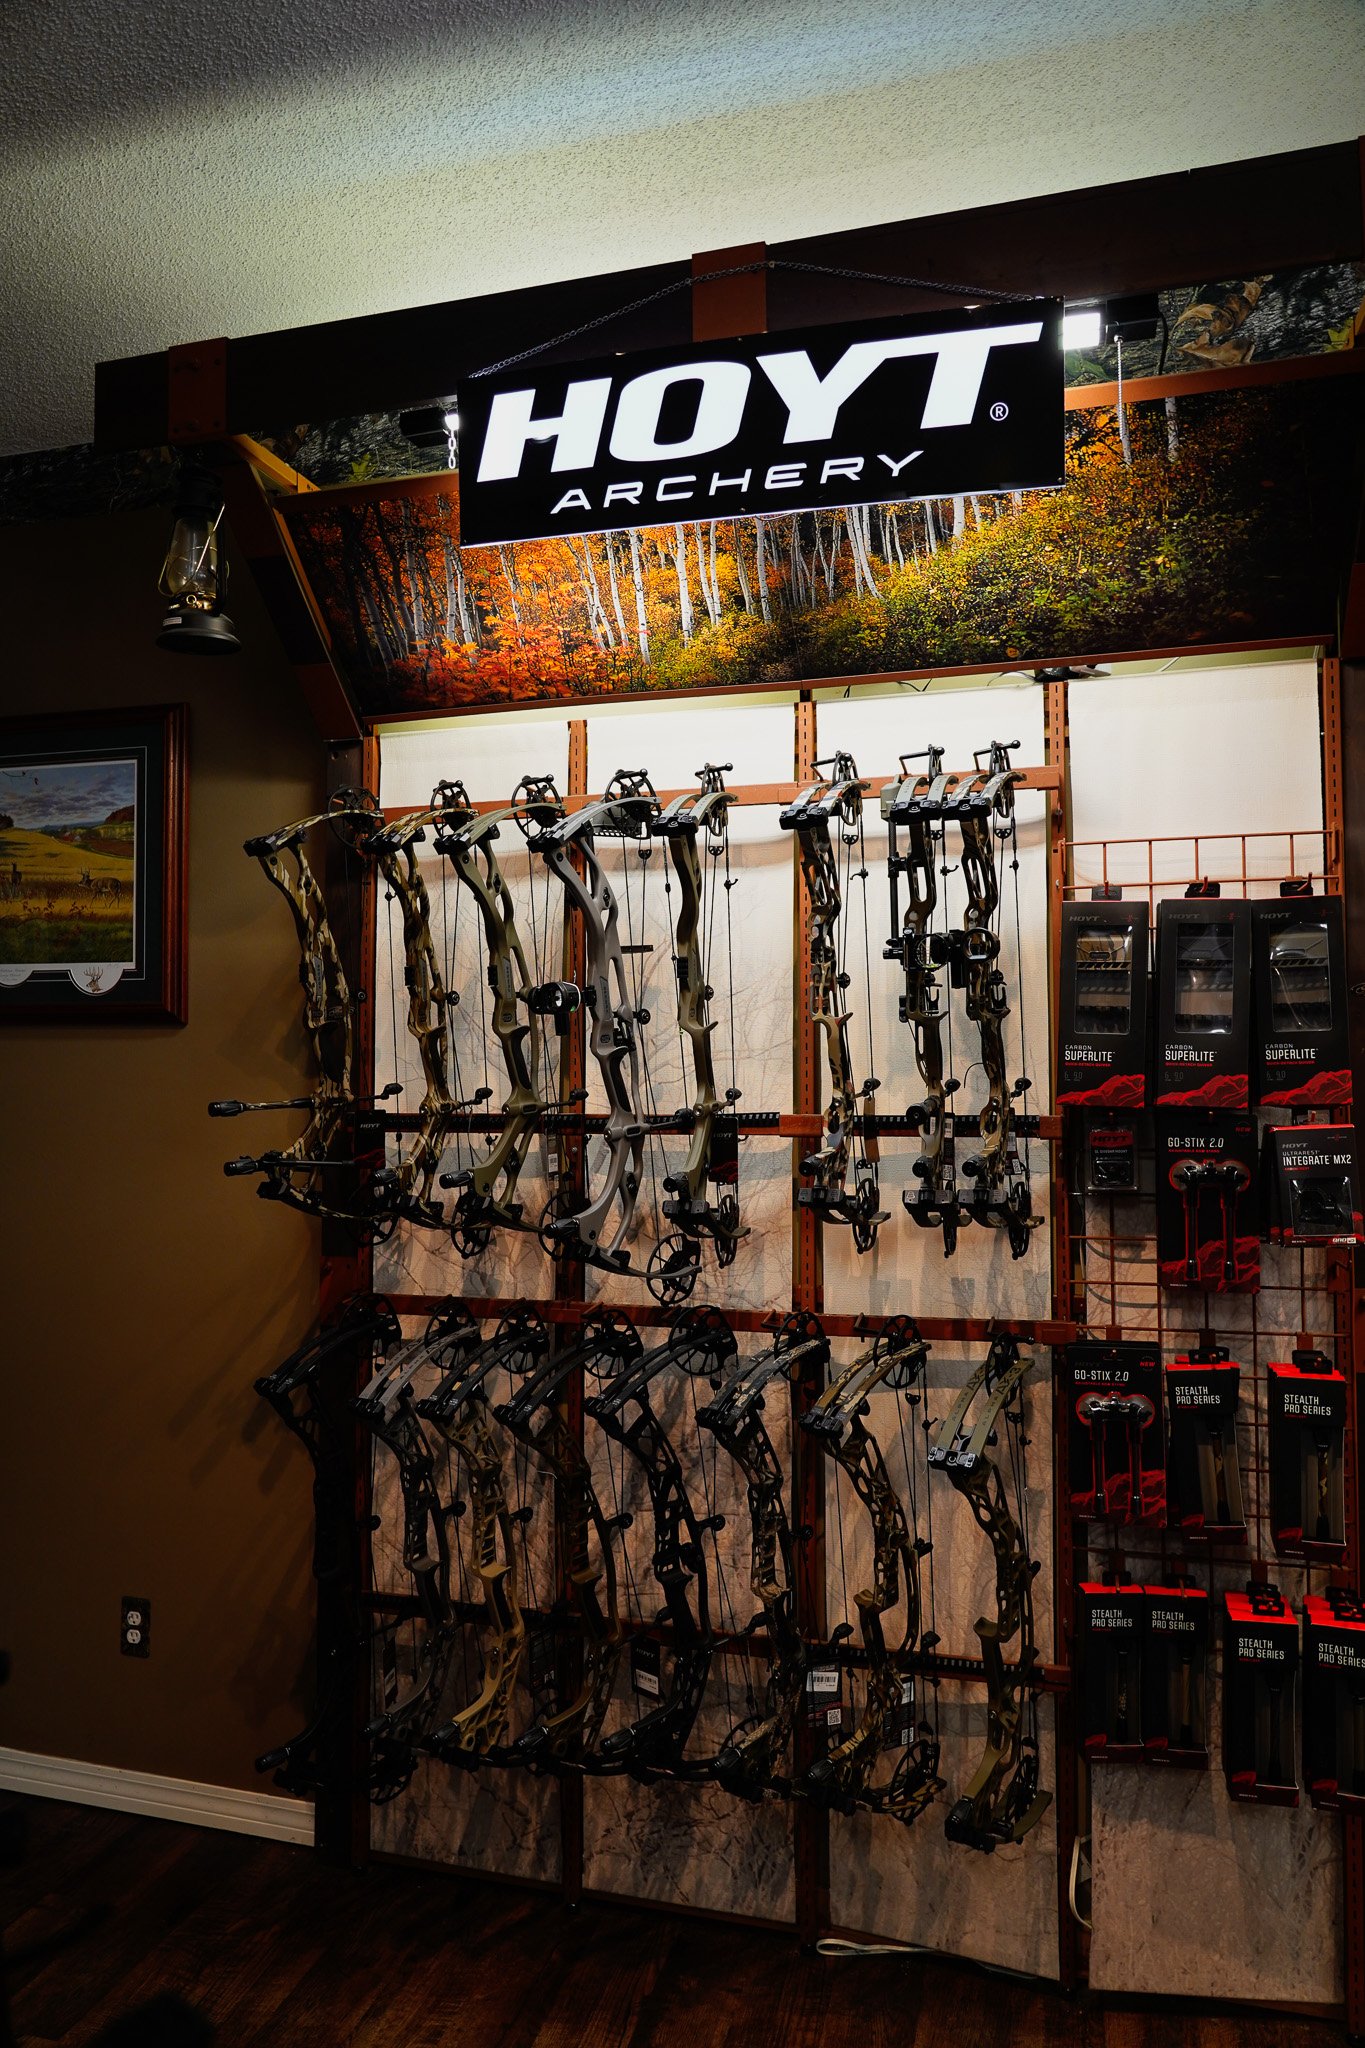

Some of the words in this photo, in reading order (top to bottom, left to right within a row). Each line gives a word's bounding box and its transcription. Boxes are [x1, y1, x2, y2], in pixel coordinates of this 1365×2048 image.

[477, 321, 1044, 483] HOYT
[550, 449, 925, 515] ARCHERY
[1065, 1050, 1113, 1062] SUPERLITE
[1165, 1050, 1215, 1062] SUPERLITE
[1265, 1048, 1316, 1060] SUPERLITE
[1168, 1137, 1205, 1148] GO-STIX
[1209, 1137, 1224, 1148] 2.0
[1283, 1155, 1330, 1166] INTEGRATE
[1333, 1154, 1352, 1165] MX2
[1074, 1370, 1111, 1381] GO-STIX
[1114, 1371, 1129, 1382] 2.0
[1175, 1386, 1208, 1395] STEALTH
[1176, 1396, 1191, 1405] PRO
[1194, 1395, 1221, 1404] SERIES
[1284, 1394, 1319, 1405] STEALTH
[1284, 1404, 1300, 1414] PRO
[1302, 1405, 1332, 1416] SERIES
[1092, 1609, 1122, 1618] STEALTH
[1152, 1610, 1184, 1621] STEALTH
[1092, 1618, 1106, 1628] PRO
[1108, 1618, 1132, 1628] SERIES
[1152, 1620, 1167, 1630] PRO
[1168, 1620, 1195, 1631] SERIES
[1238, 1638, 1273, 1649] STEALTH
[1318, 1642, 1354, 1656] STEALTH
[1238, 1648, 1254, 1658] PRO
[1256, 1648, 1285, 1660] SERIES
[1318, 1652, 1335, 1664] PRO
[1337, 1655, 1365, 1668] SERIES
